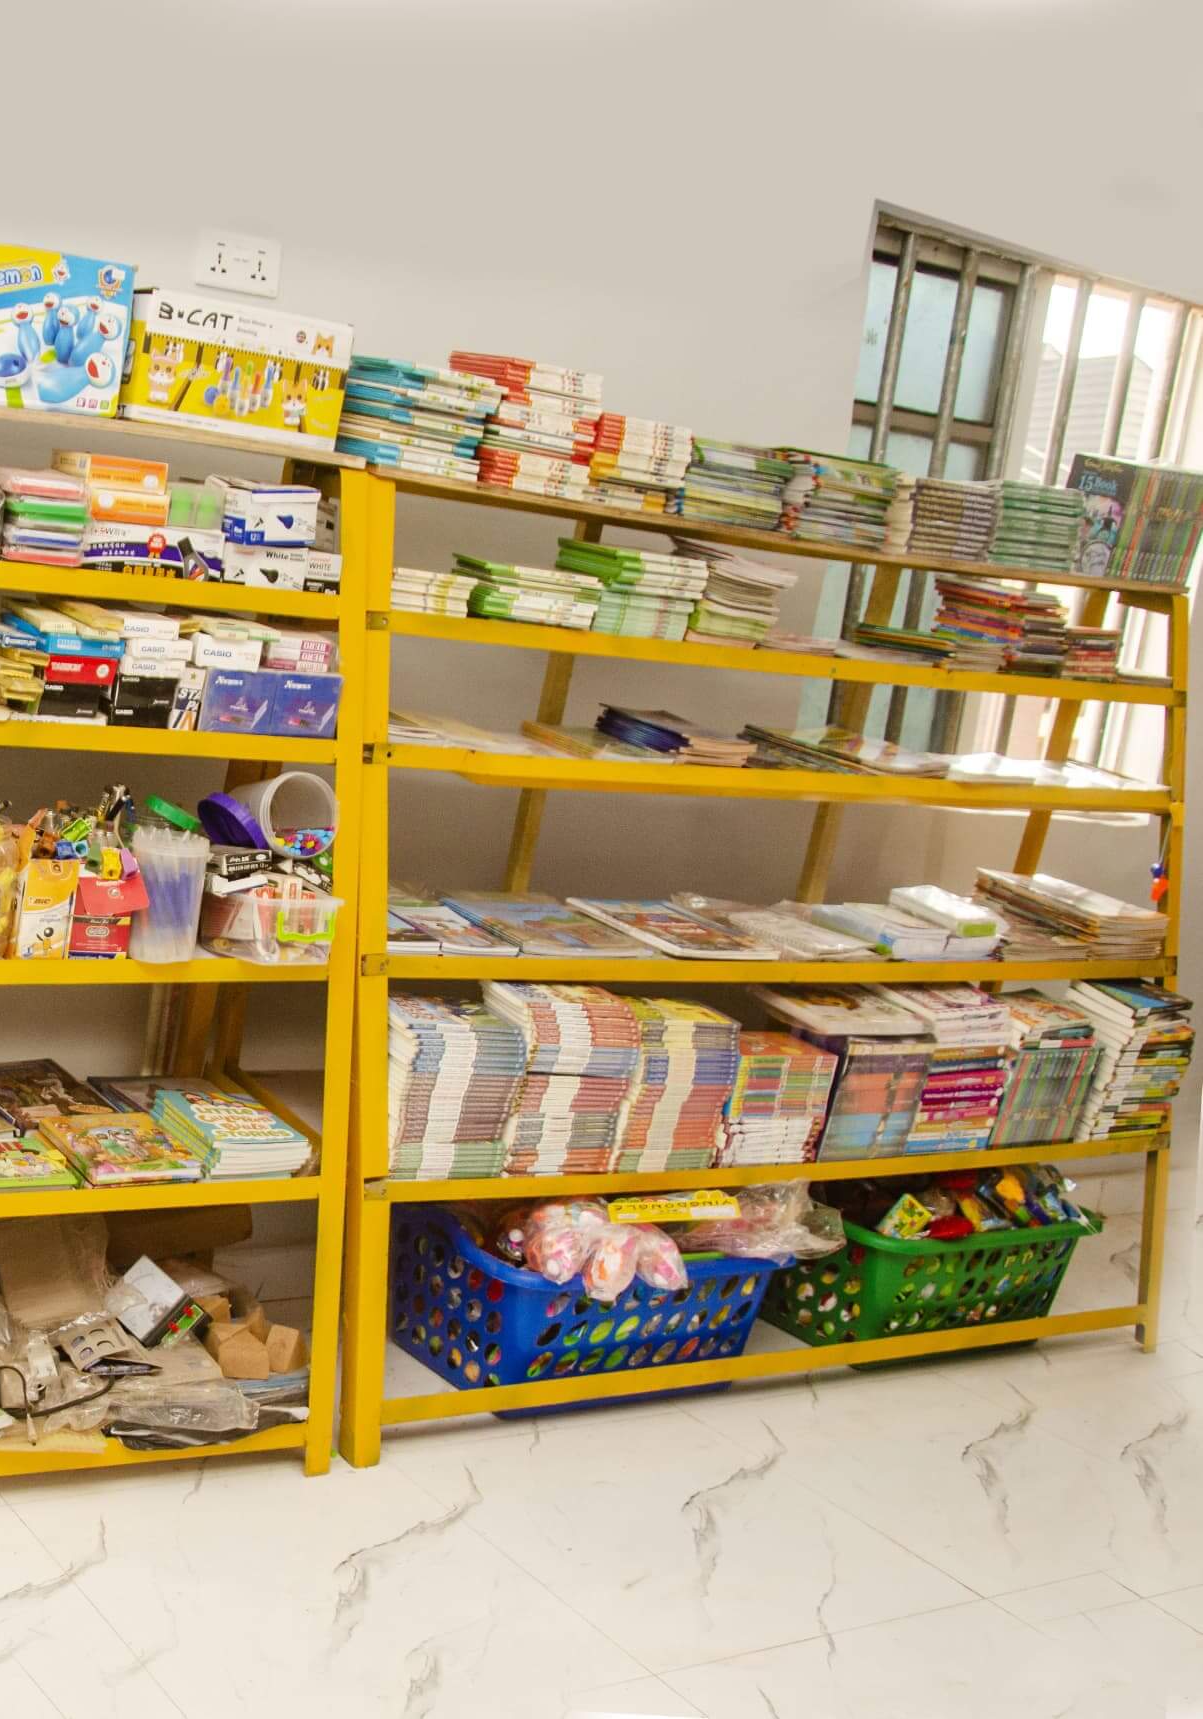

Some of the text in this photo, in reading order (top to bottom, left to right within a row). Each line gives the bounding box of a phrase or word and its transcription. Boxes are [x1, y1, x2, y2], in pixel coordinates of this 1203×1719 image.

[266, 551, 289, 560] White
[124, 625, 150, 633] CASIO
[141, 645, 166, 653] CASIO
[203, 648, 232, 658] CASIO
